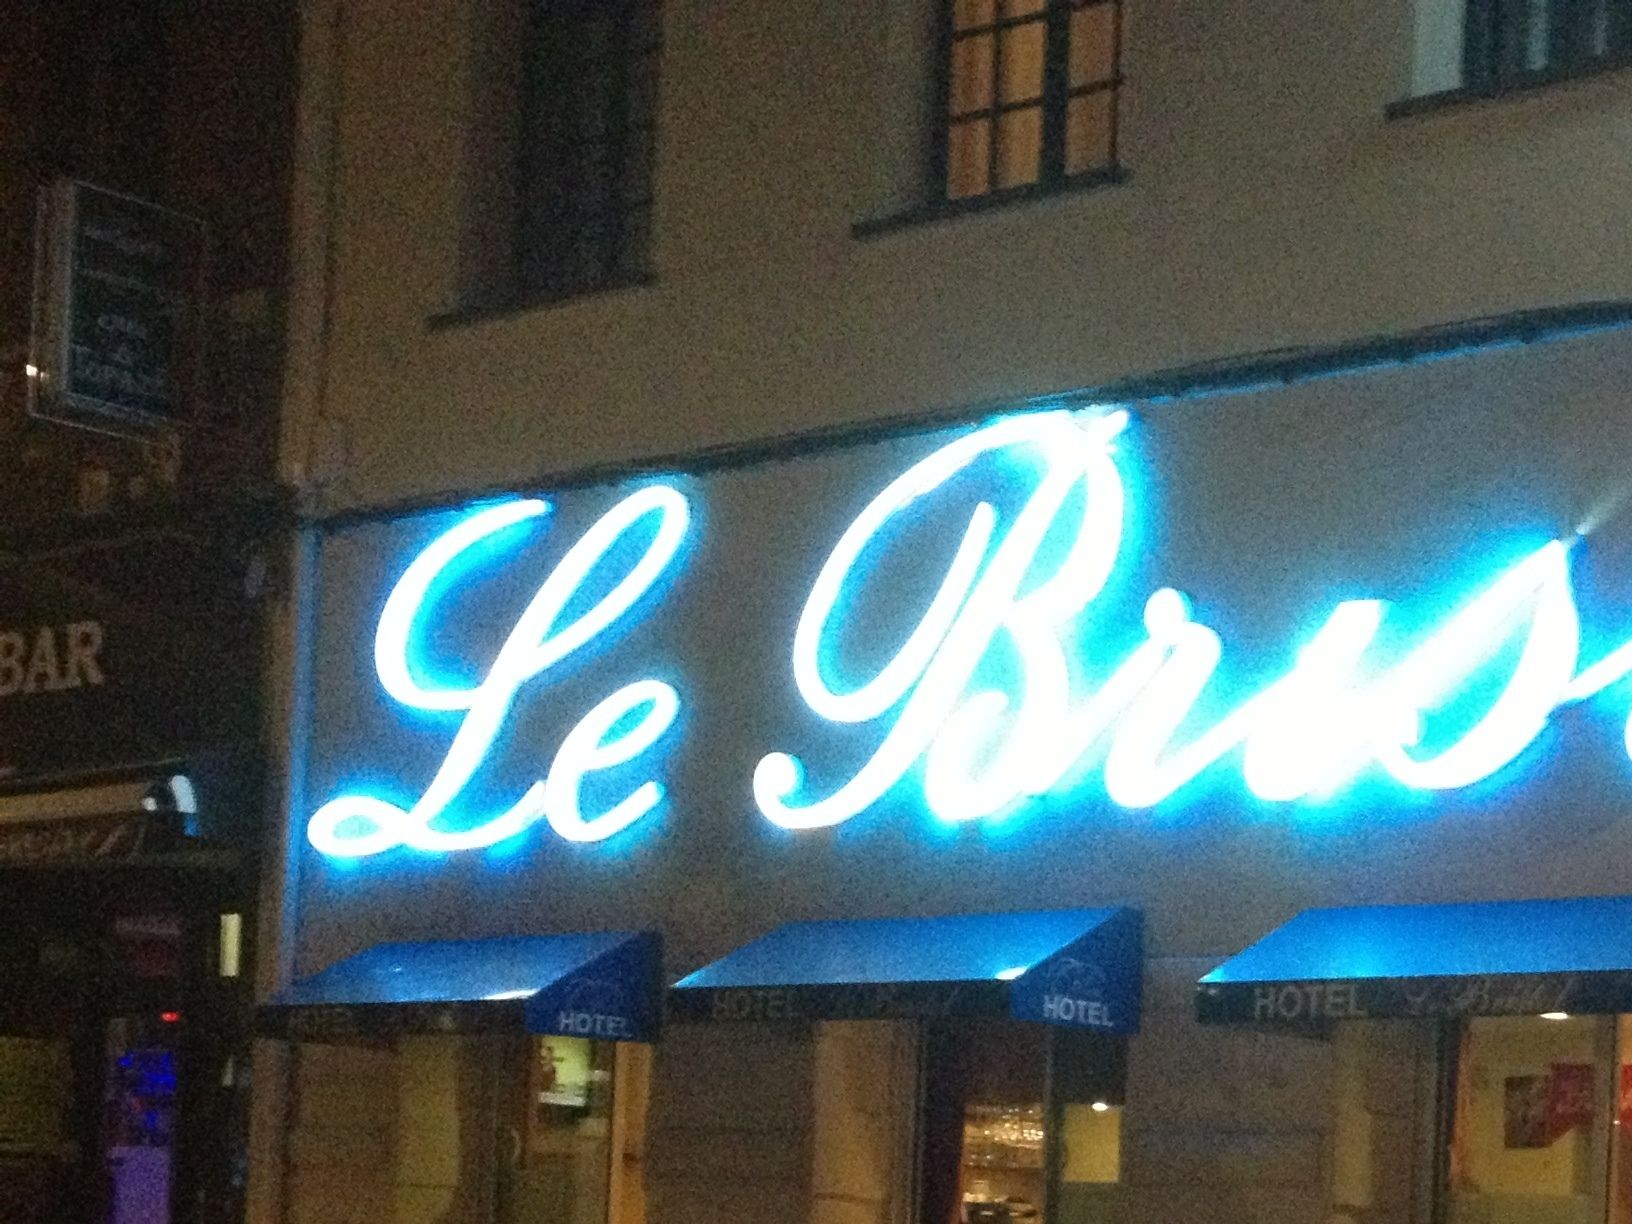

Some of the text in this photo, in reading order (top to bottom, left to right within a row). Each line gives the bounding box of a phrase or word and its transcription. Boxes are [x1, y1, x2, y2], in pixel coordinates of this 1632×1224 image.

[0, 621, 104, 695] BAR
[304, 482, 690, 857] Le
[1042, 994, 1115, 1027] HOTEL
[1253, 984, 1369, 1020] HOTEL
[558, 1010, 634, 1038] HOTEL
